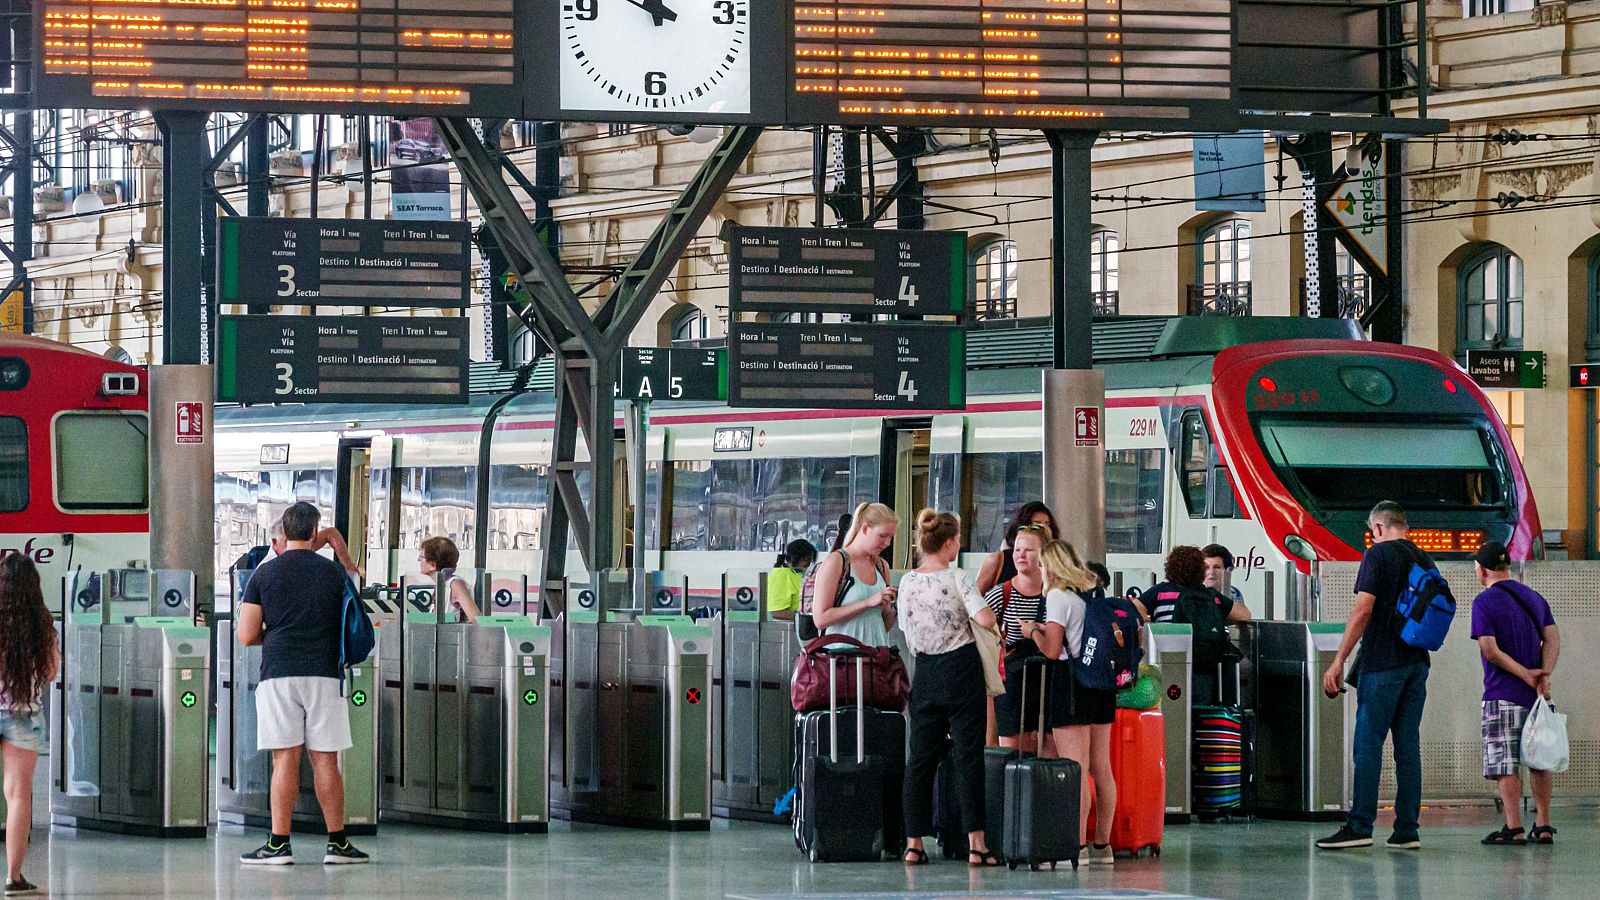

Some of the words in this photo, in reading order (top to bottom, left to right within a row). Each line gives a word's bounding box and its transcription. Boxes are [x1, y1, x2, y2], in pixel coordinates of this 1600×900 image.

[576, 0, 599, 21] 9
[712, 1, 734, 24] 3
[644, 72, 666, 96] 6
[320, 229, 339, 237] Hora
[384, 230, 400, 238] Tren
[409, 231, 426, 239] Tren
[283, 240, 296, 248] Via
[741, 237, 760, 245] Hora
[801, 238, 817, 246] Tren
[824, 239, 841, 247] Tren
[899, 251, 910, 259] Via
[360, 258, 402, 266] Destinació
[741, 265, 769, 273] Destino
[779, 265, 818, 275] Destinació
[277, 265, 295, 297] 3
[296, 289, 320, 297] Sector
[898, 276, 919, 306] 4
[875, 298, 896, 306] Sector
[318, 327, 337, 335] Hora
[382, 327, 398, 335] Tren
[407, 328, 424, 336] Tren
[740, 333, 758, 341] Hora
[800, 334, 816, 342] Tren
[823, 334, 840, 343] Tren
[282, 338, 294, 346] Via
[897, 346, 909, 354] Via
[318, 355, 348, 363] Destino
[358, 355, 400, 364] Destinació
[1480, 357, 1500, 365] Aseos
[740, 361, 769, 369] Destino
[778, 361, 818, 371] Destinació
[1471, 367, 1500, 375] Lavabos
[275, 363, 293, 394] 3
[638, 376, 652, 397] A
[671, 377, 683, 398] 5
[897, 371, 918, 401] 4
[294, 387, 318, 395] Sector
[874, 393, 896, 401] Sector
[1130, 419, 1147, 436] 229
[1149, 419, 1157, 436] M
[1082, 637, 1098, 666] SEB
